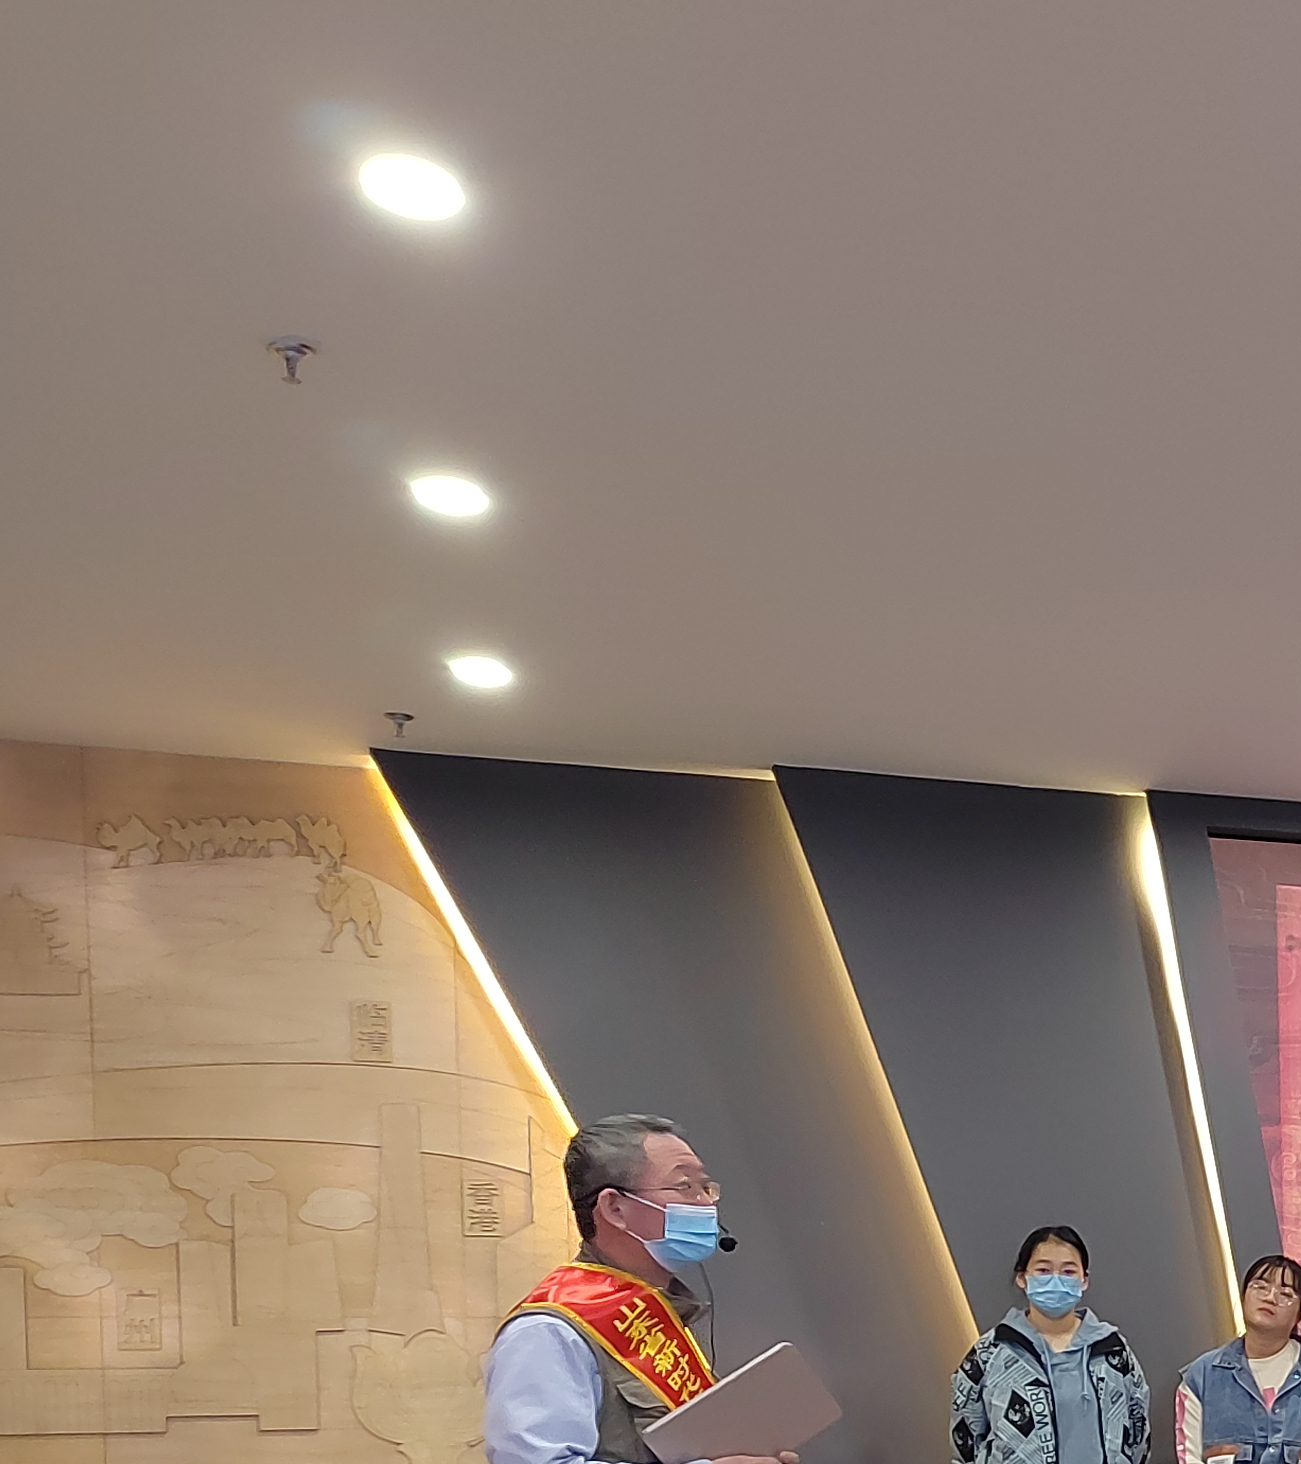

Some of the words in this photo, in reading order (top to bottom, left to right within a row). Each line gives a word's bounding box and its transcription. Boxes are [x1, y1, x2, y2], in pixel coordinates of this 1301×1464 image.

[613, 1296, 703, 1405] 山东省新时代
